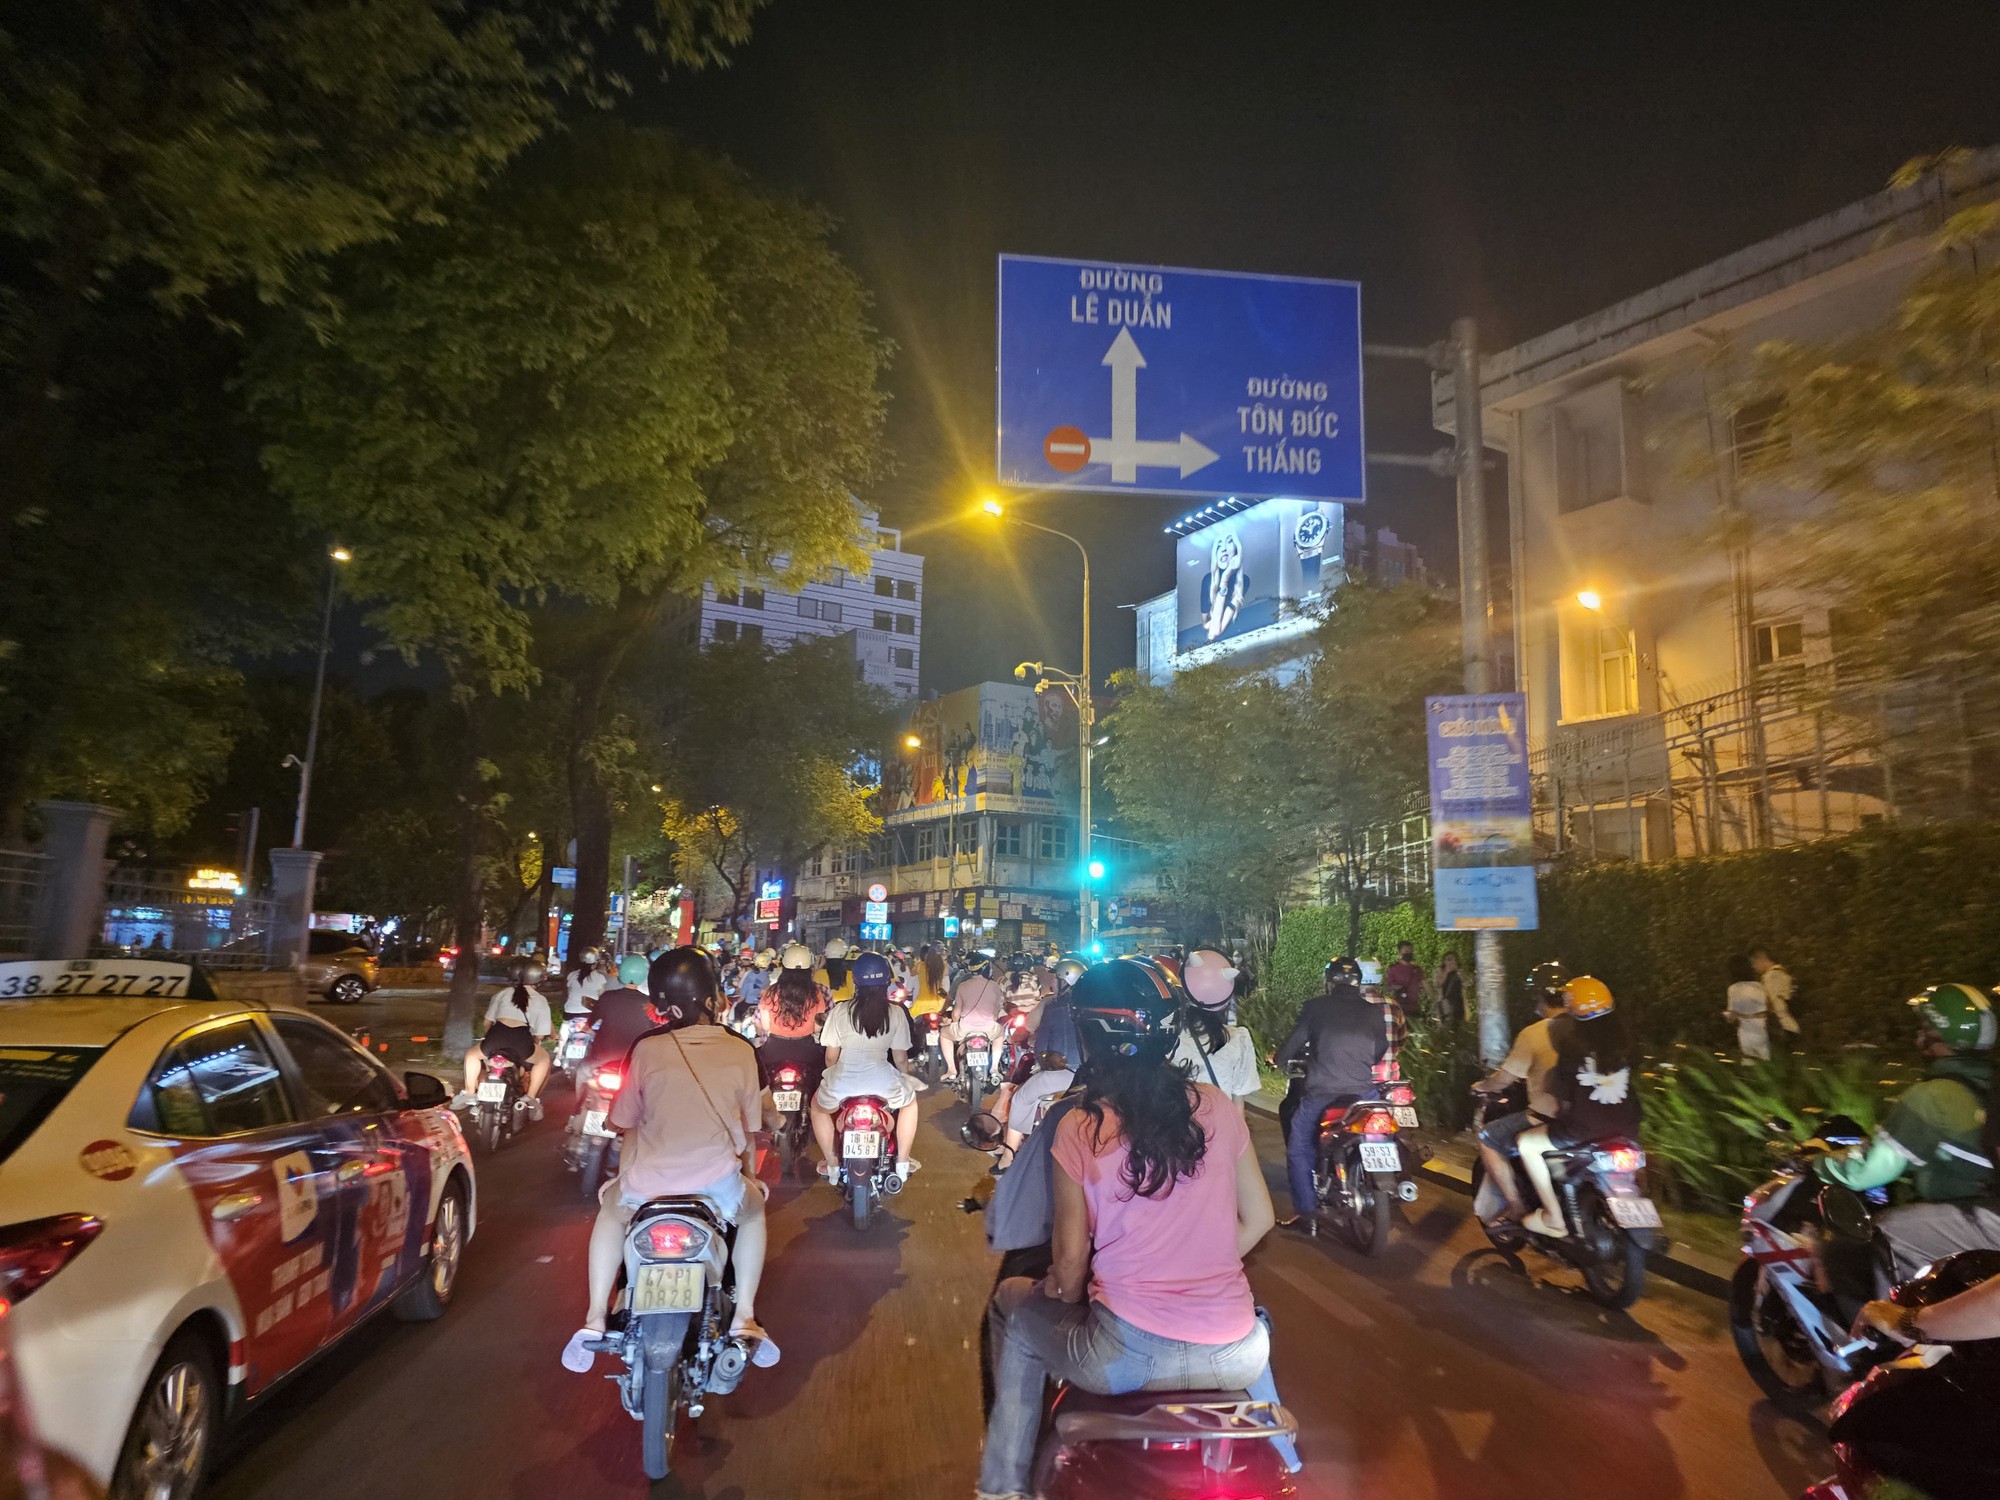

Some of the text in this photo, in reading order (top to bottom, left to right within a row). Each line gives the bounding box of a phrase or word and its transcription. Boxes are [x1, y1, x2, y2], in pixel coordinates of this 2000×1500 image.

[1071, 291, 1099, 324] LÊ
[1246, 373, 1328, 402] ĐƯỜNG
[1237, 402, 1339, 439] TÔN ĐỨC
[1242, 437, 1321, 475] THẮNG
[96, 975, 140, 995] 27
[142, 975, 186, 996] 27
